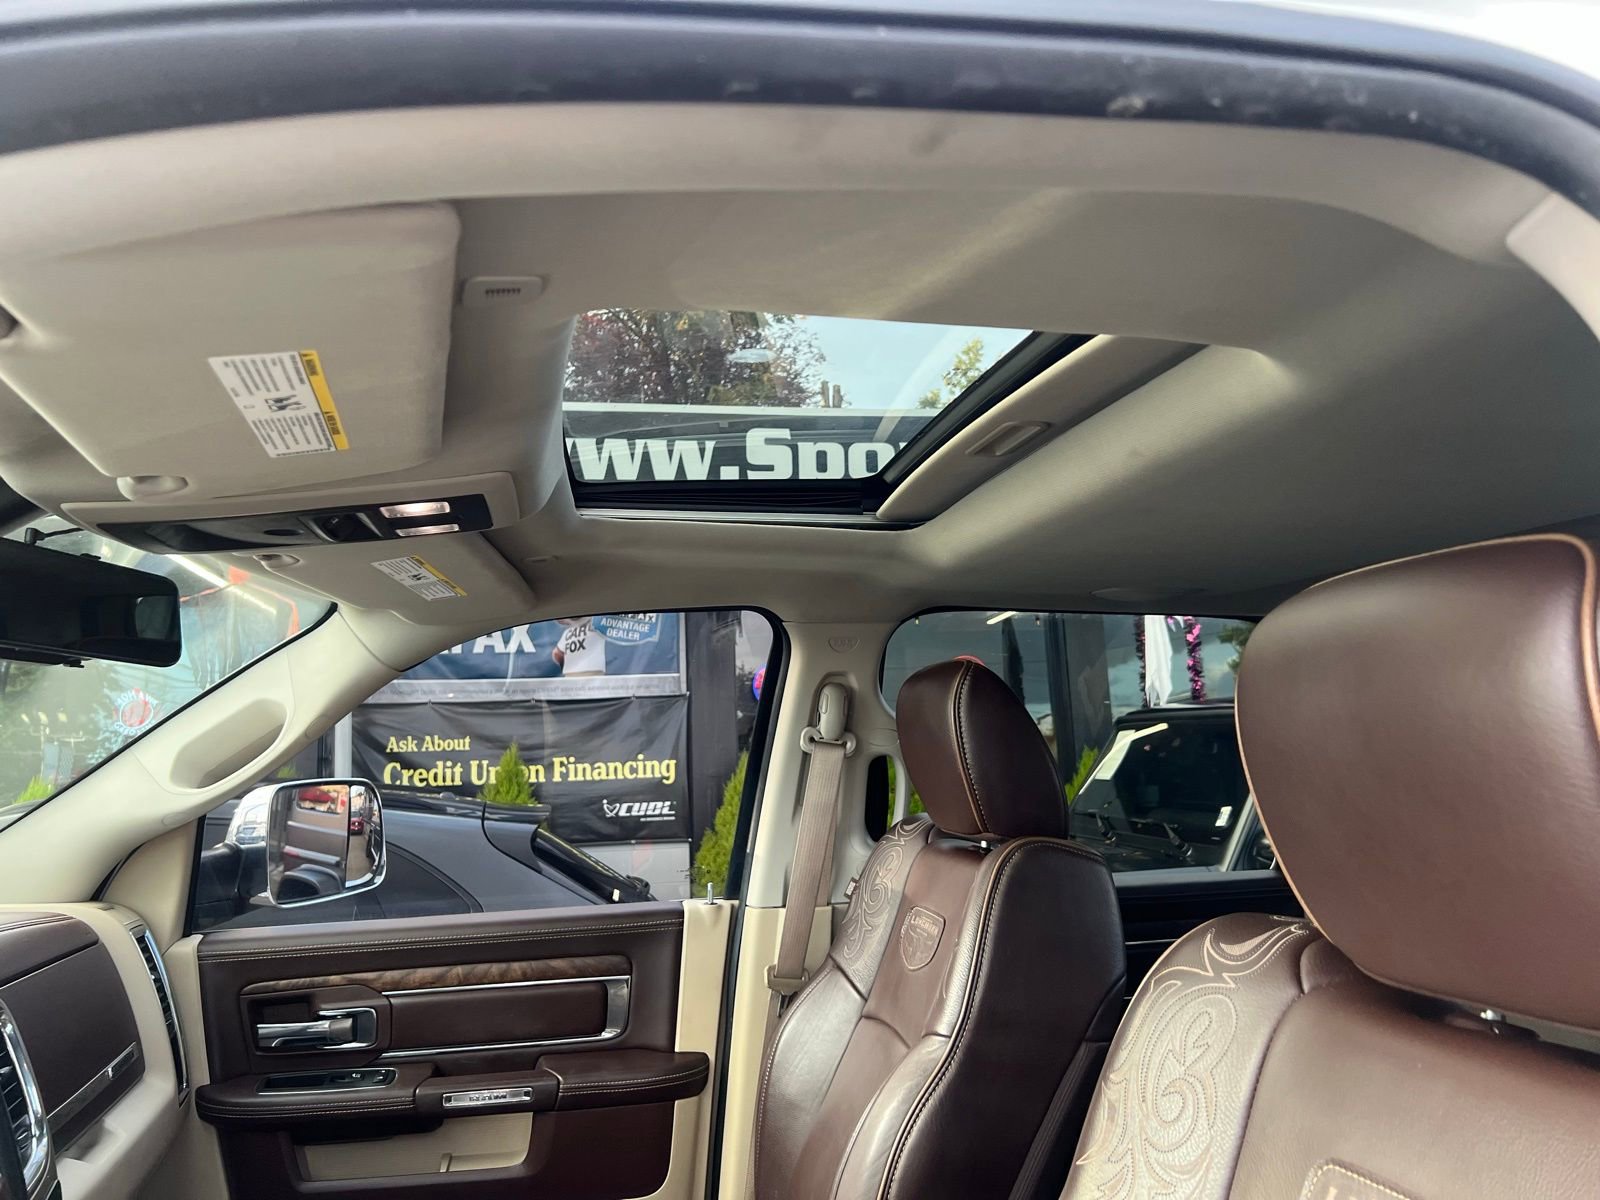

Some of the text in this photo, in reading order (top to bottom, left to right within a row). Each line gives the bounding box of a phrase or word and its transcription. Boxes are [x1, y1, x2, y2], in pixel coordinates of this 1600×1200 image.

[565, 428, 907, 480] ww.Spo
[600, 617, 650, 633] ADVANTAGE
[606, 628, 640, 641] DEALER
[565, 638, 587, 655] FOX
[386, 735, 471, 753] Ask About
[384, 761, 463, 787] Credit
[552, 754, 677, 784] Financing
